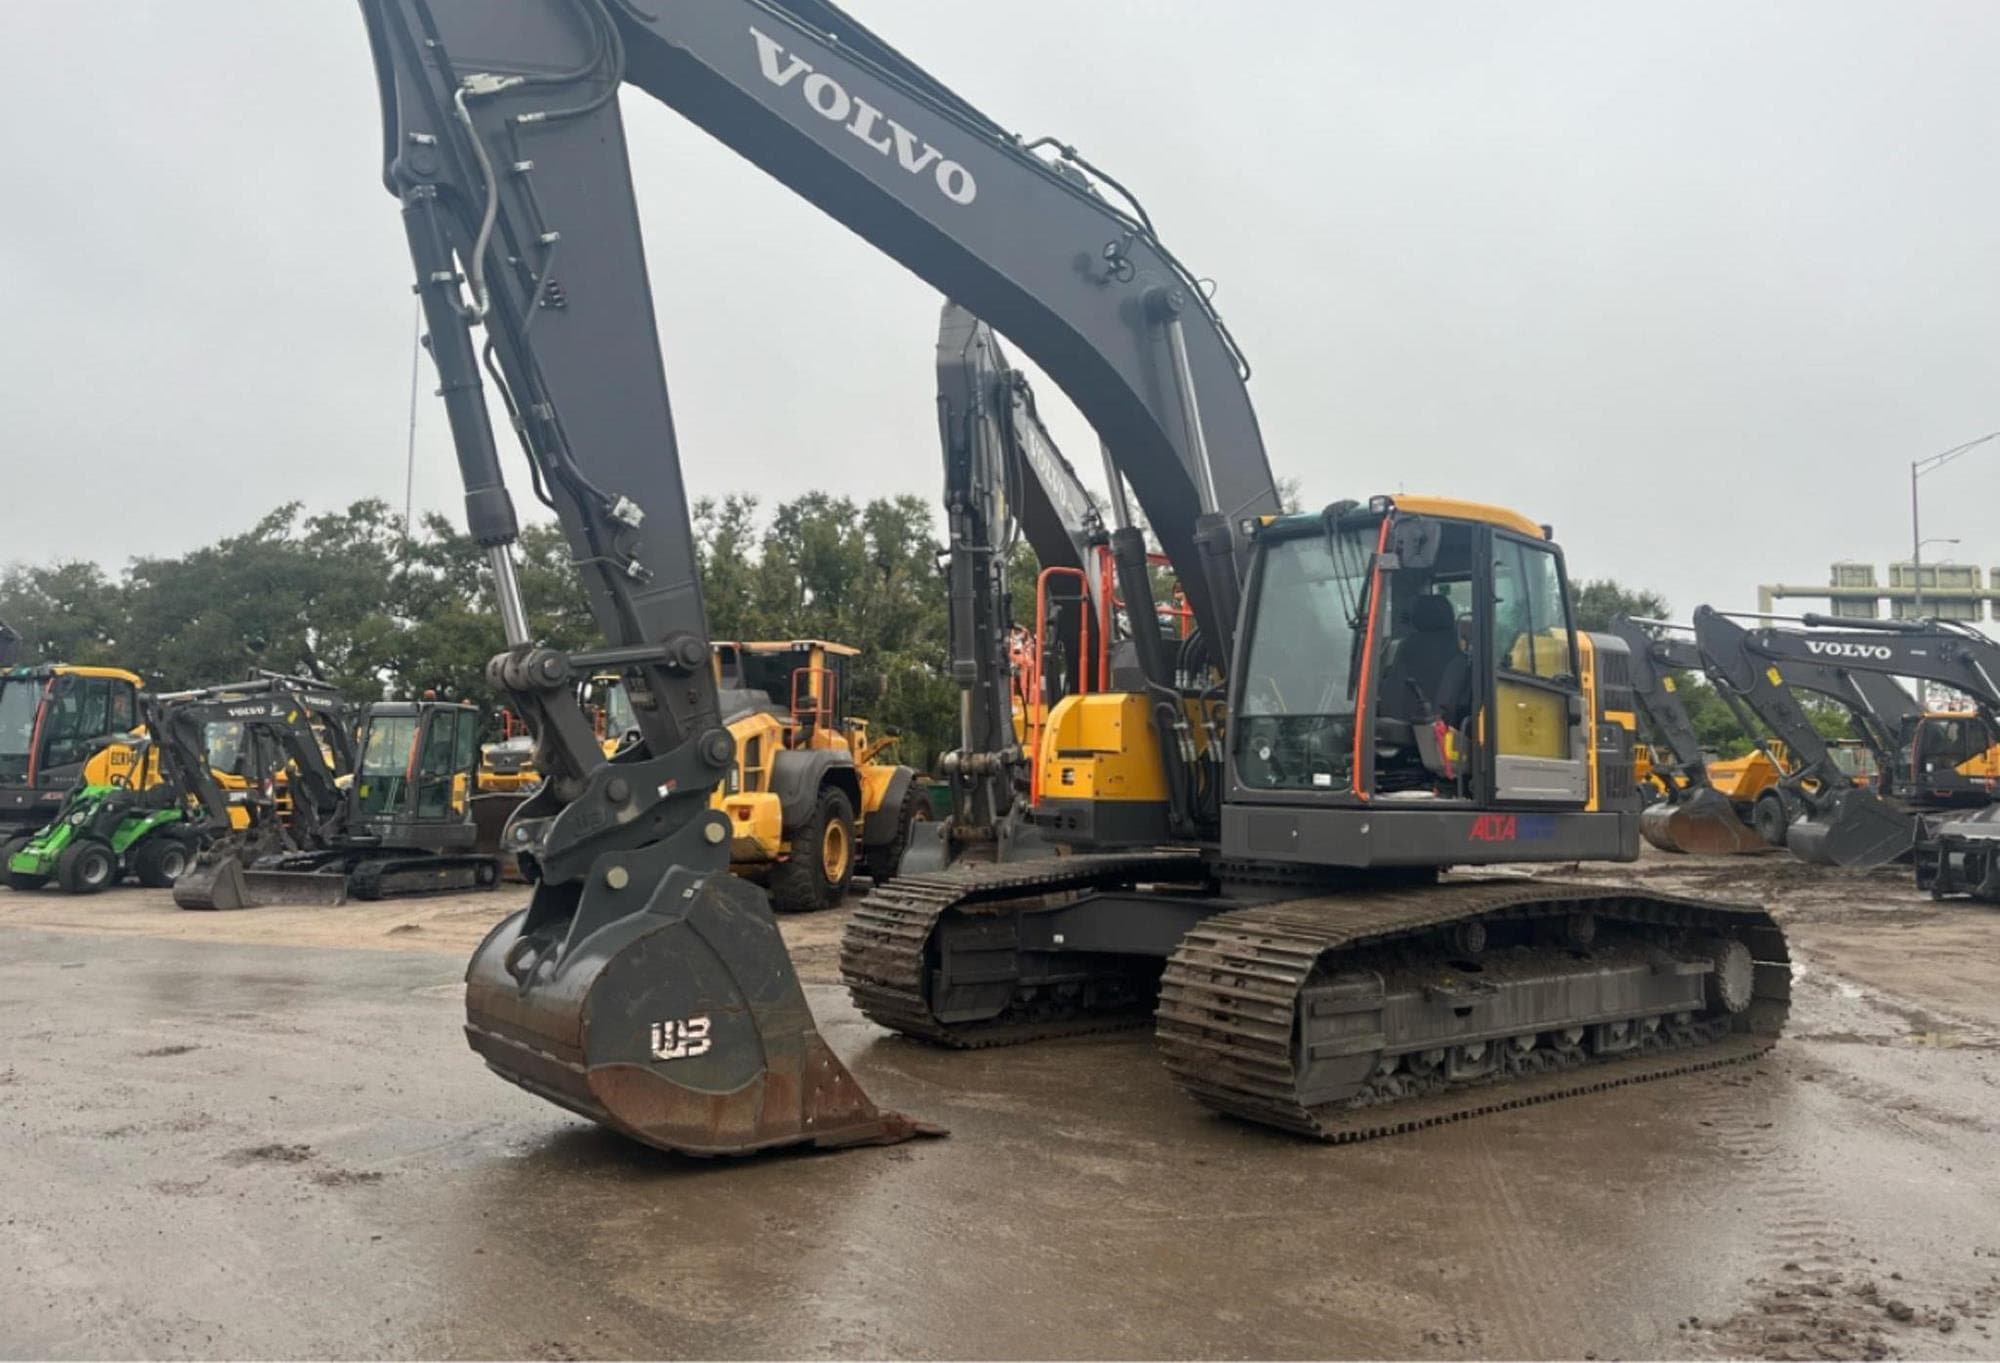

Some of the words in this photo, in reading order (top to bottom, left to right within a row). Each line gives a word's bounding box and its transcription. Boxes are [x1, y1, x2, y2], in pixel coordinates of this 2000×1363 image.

[749, 26, 977, 205] VOLVO
[1805, 641, 1892, 659] VOLVO
[228, 706, 265, 716] VOLVO
[1469, 814, 1517, 842] ALTA
